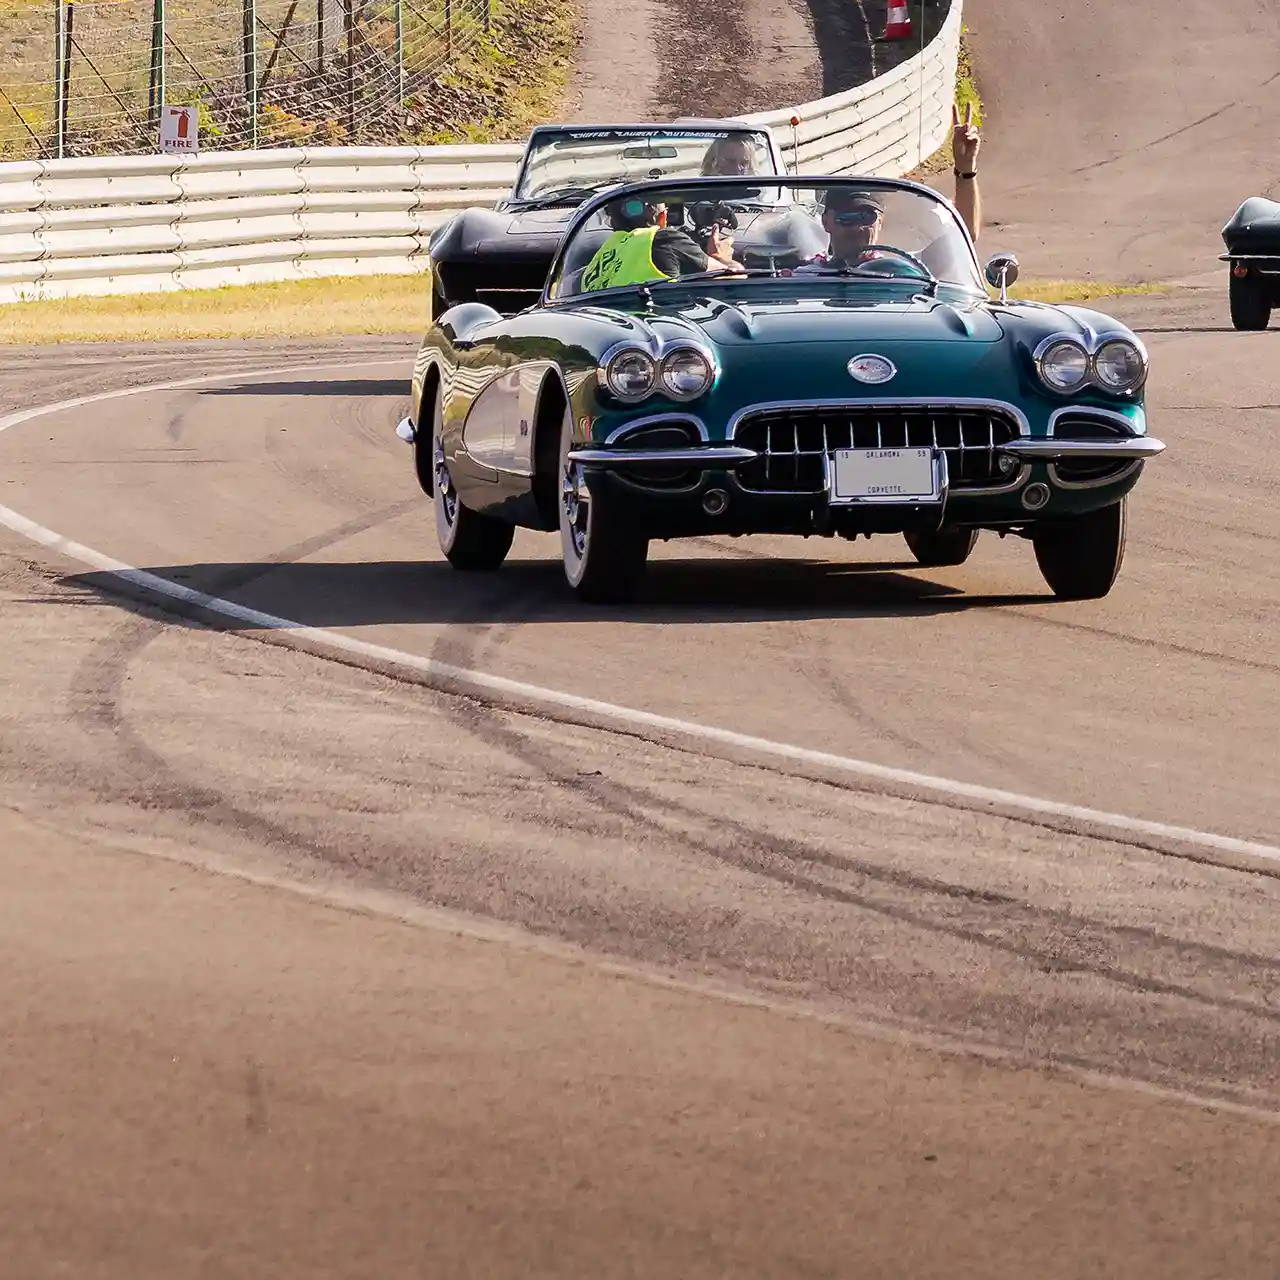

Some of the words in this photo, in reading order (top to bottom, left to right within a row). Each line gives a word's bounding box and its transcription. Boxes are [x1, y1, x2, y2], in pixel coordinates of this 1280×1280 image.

[661, 130, 730, 139] AUTOMOBILES
[164, 139, 193, 148] FIRE
[867, 485, 902, 494] CORVETTE
